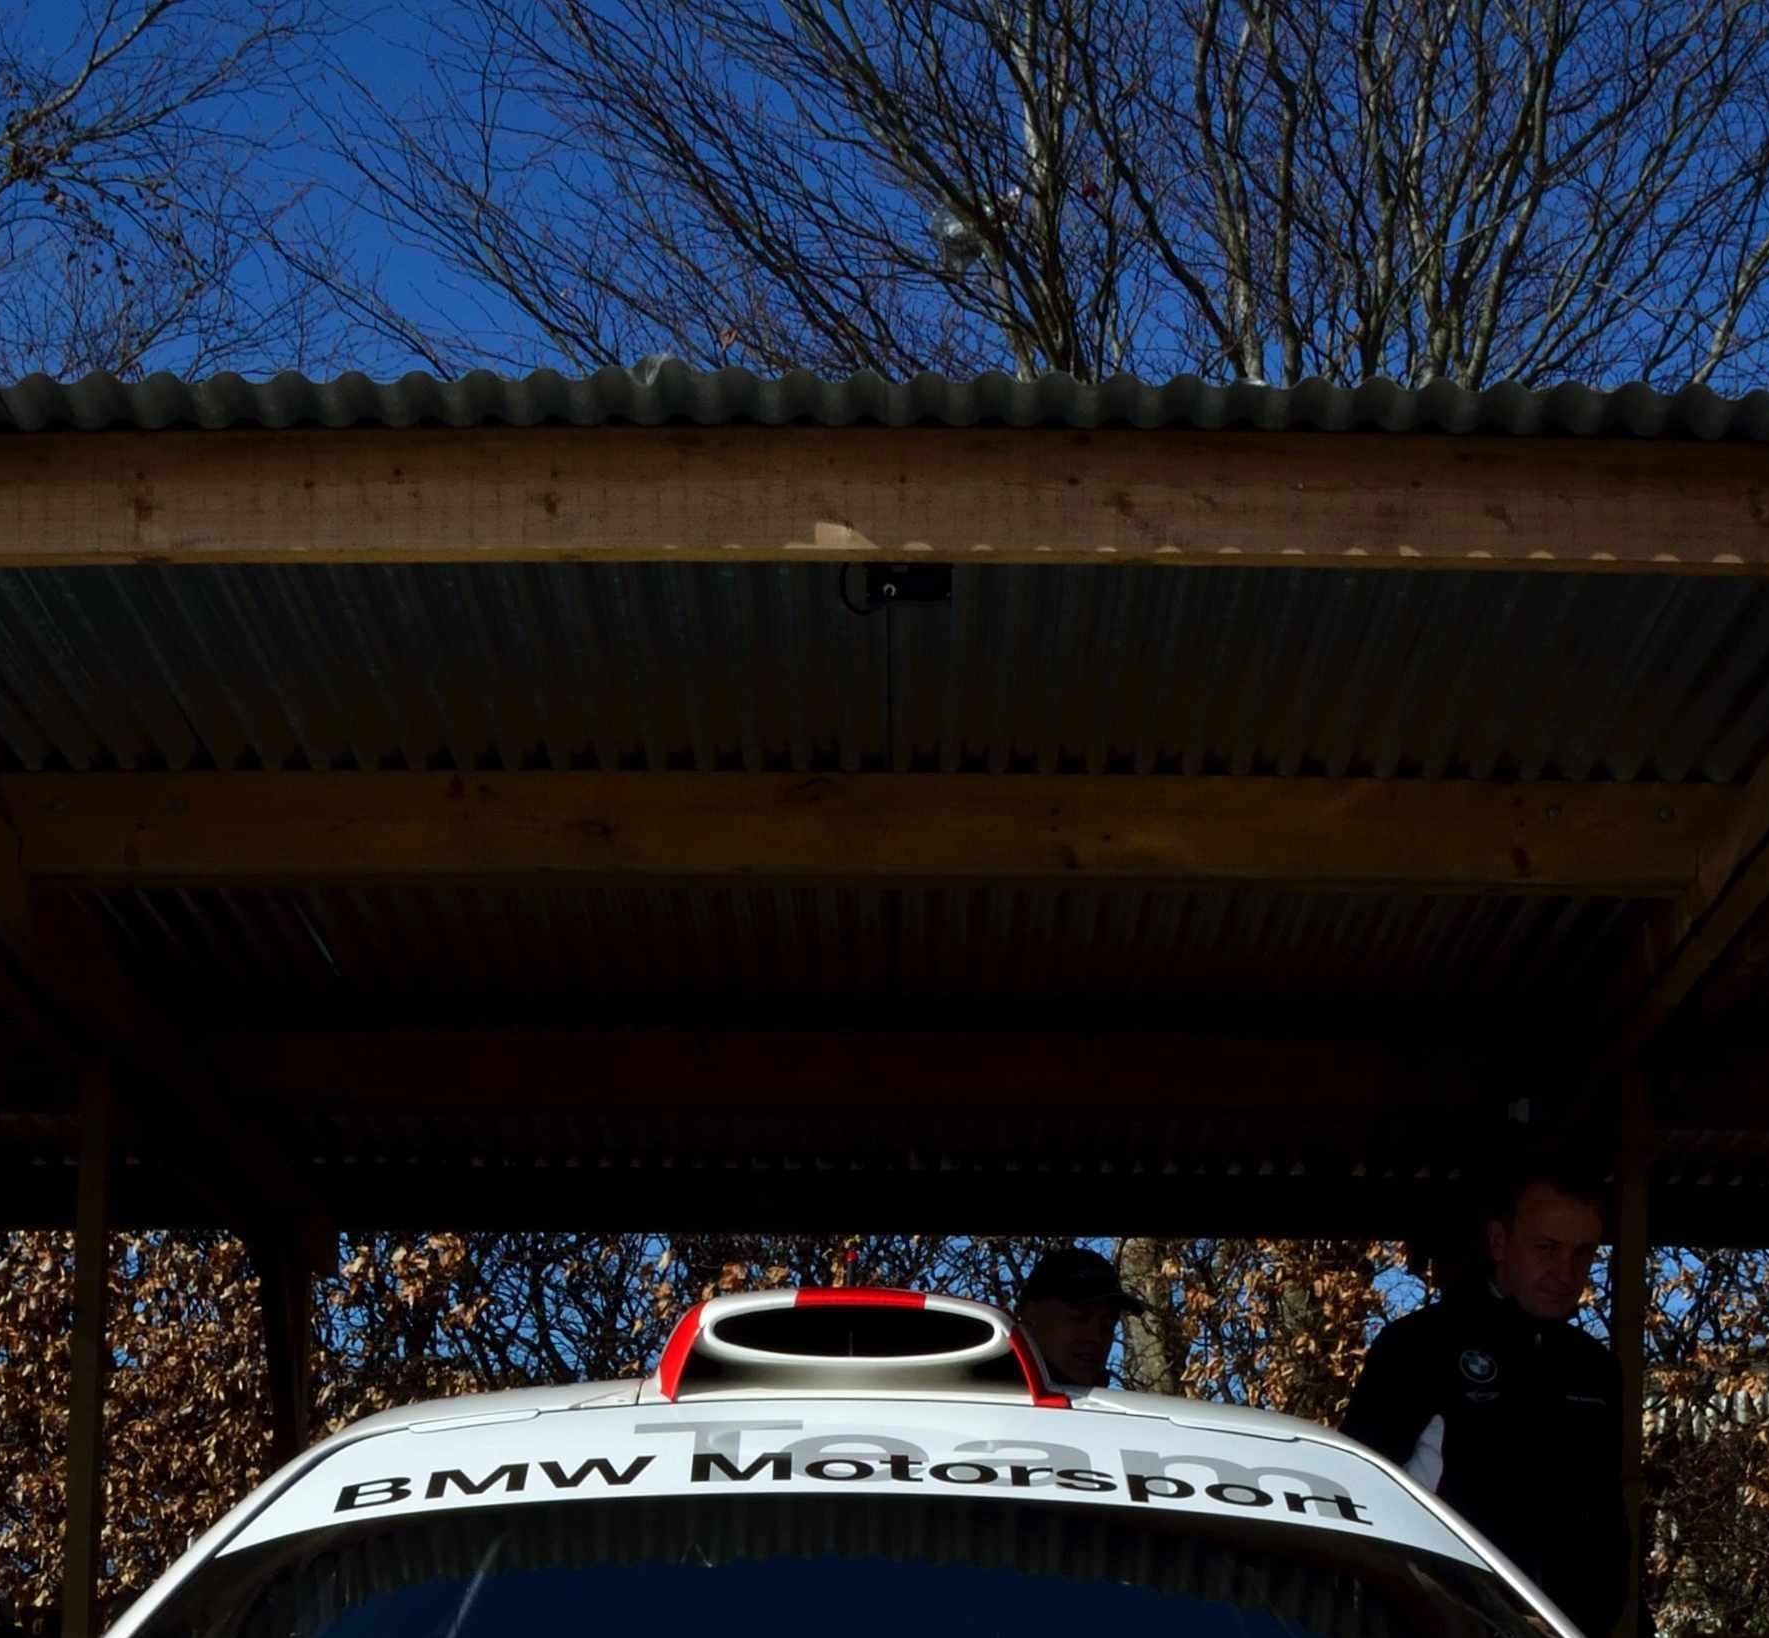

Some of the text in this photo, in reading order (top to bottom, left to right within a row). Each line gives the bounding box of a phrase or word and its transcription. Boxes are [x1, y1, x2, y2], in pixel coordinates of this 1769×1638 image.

[333, 1452, 1373, 1526] BMW Motorsport
[634, 1420, 1357, 1517] Team
